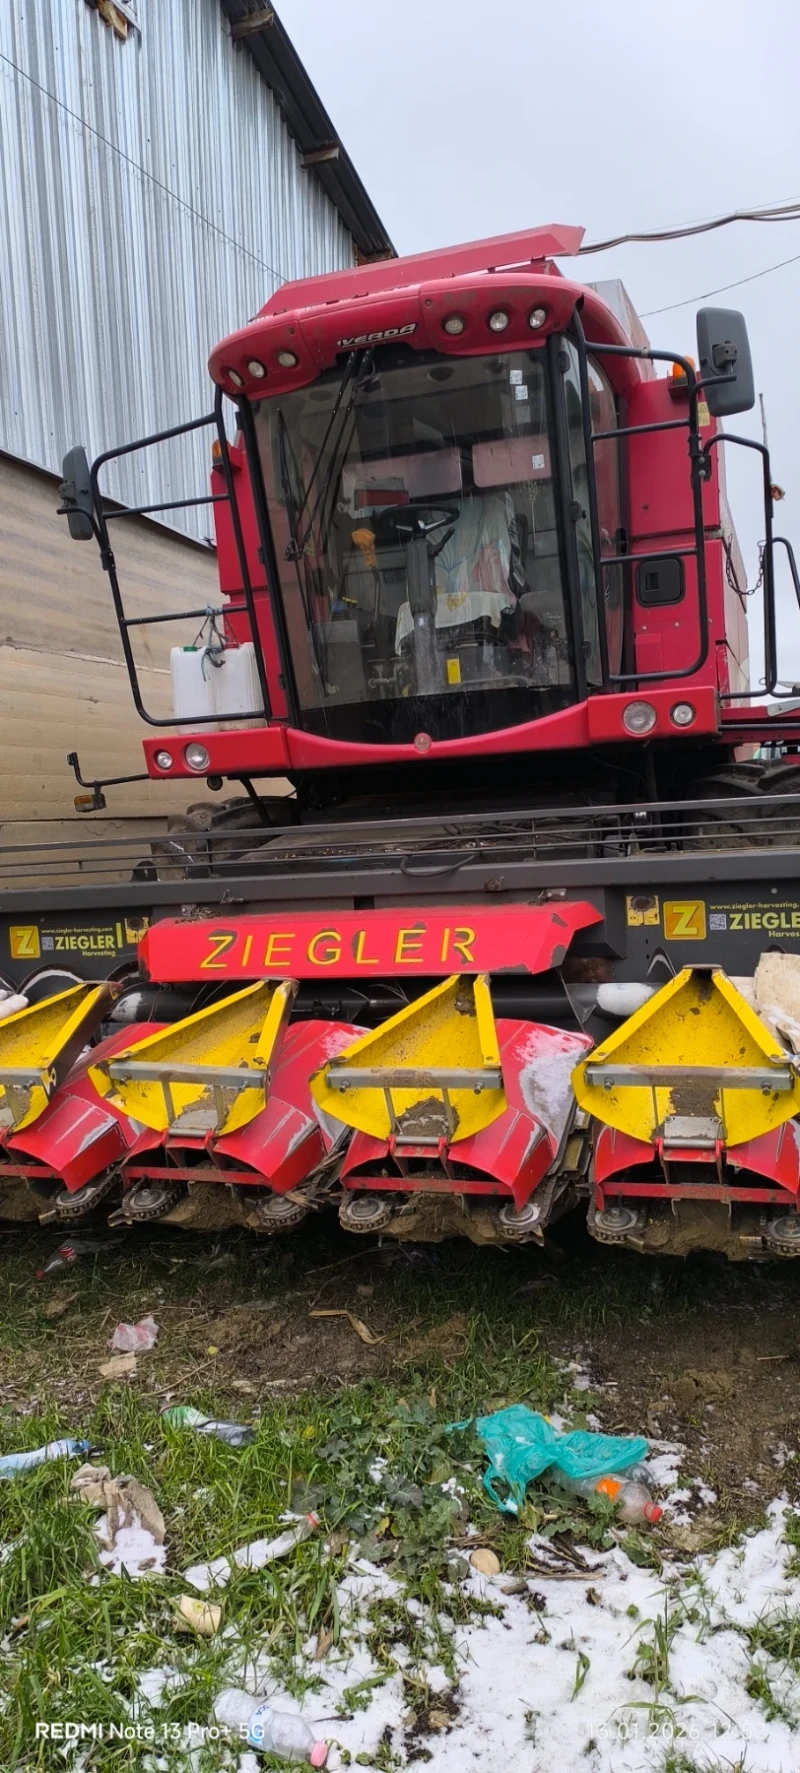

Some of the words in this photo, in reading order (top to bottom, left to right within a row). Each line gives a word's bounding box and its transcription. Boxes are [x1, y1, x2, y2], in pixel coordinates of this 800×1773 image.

[337, 323, 417, 346] VERDA
[709, 902, 800, 910] www.ziegler-harvesting.
[672, 905, 698, 935] Z
[729, 912, 800, 929] ZIEGLE
[16, 930, 35, 955] Z
[55, 935, 115, 950] ZIEGLER
[768, 930, 800, 938] Harves
[82, 949, 116, 957] Harvesting
[200, 927, 476, 968] ZIEGLER
